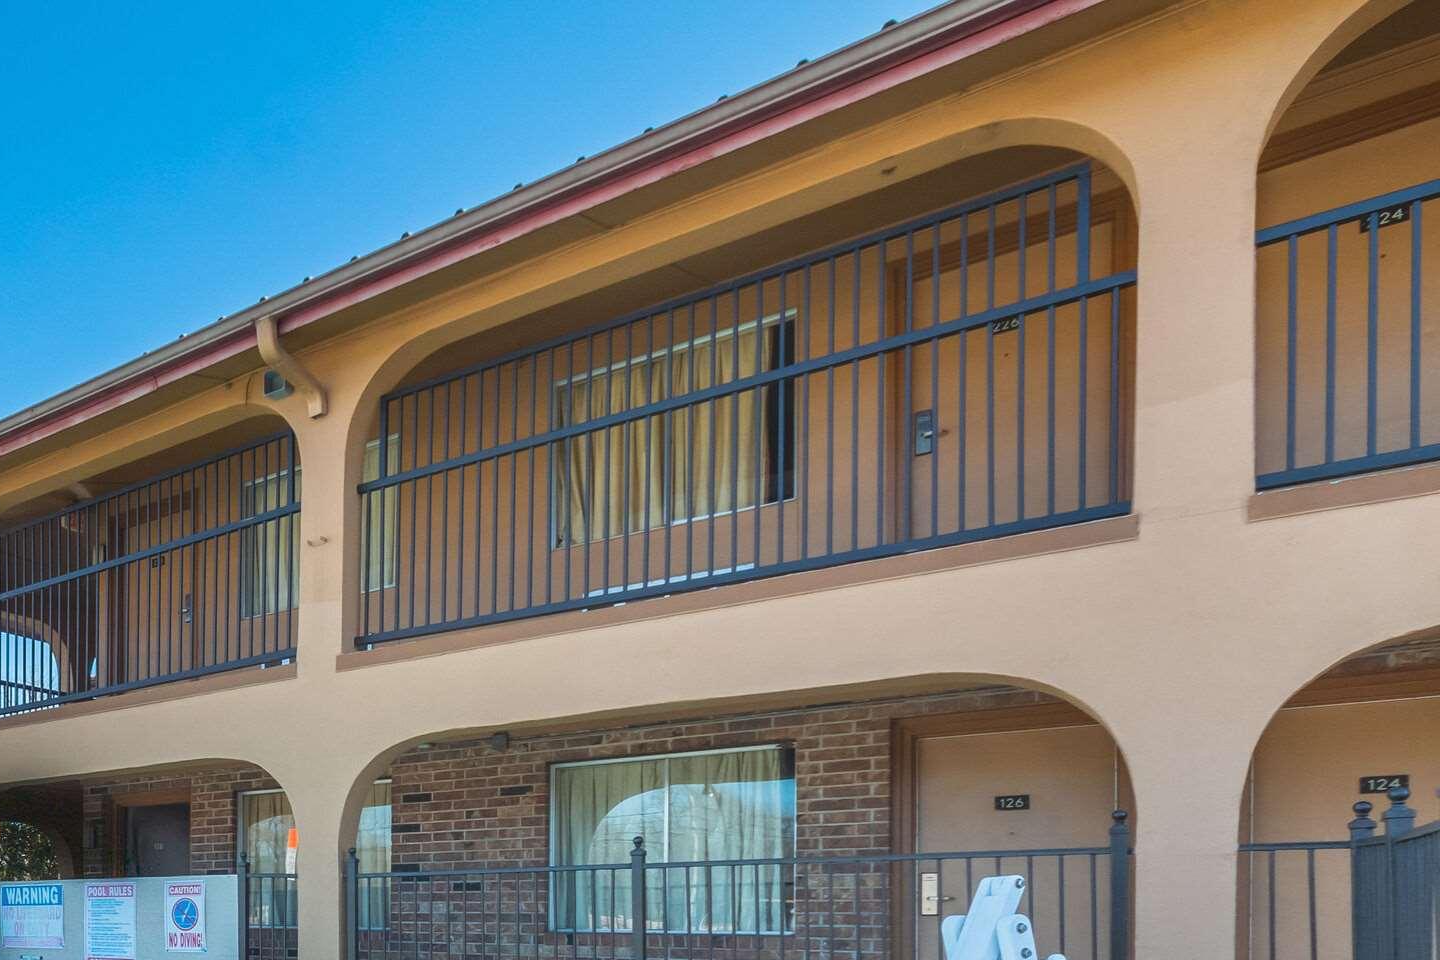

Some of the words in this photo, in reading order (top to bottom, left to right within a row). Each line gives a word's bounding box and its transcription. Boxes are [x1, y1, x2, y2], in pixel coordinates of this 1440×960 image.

[1365, 208, 1404, 229] 24
[1368, 778, 1401, 790] 124
[1000, 798, 1024, 808] 126
[6, 886, 59, 904] WARNING
[88, 887, 107, 896] POOL
[109, 886, 133, 896] RULES
[168, 932, 178, 948] NO
[180, 932, 203, 948] DIVING!
